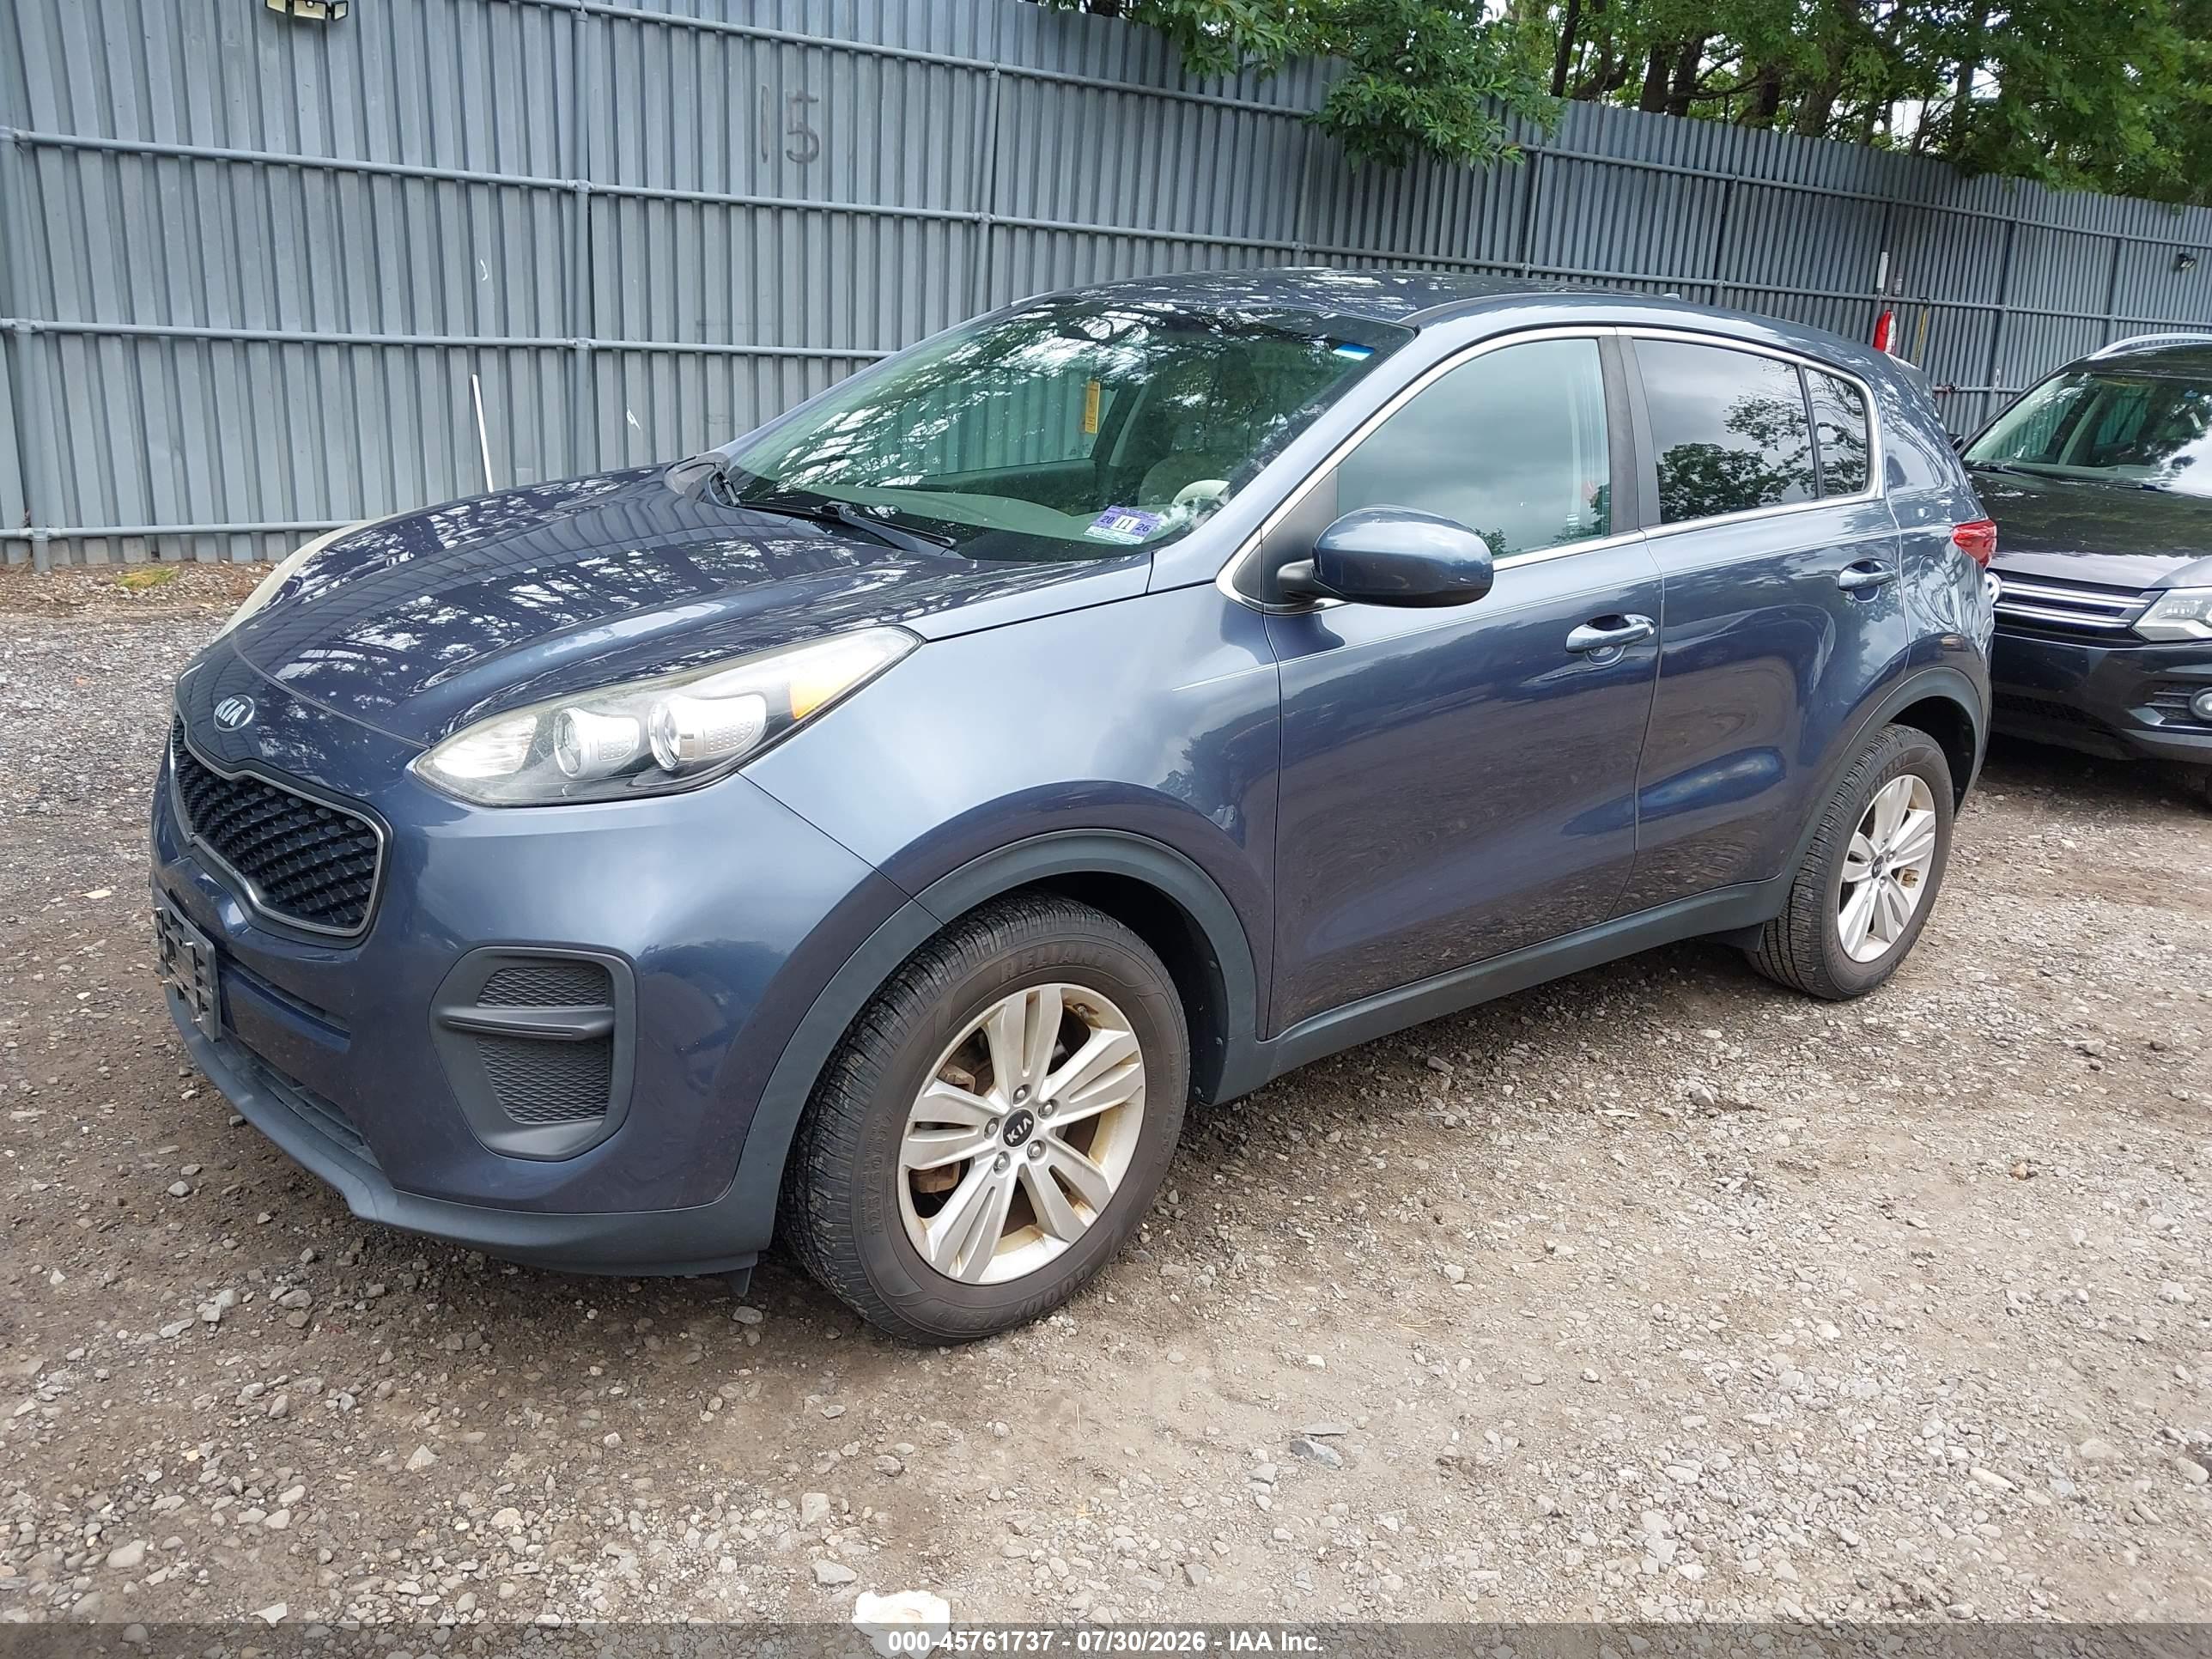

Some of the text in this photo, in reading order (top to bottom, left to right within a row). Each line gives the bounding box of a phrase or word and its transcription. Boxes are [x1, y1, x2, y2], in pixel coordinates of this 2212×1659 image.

[760, 84, 820, 165] 15
[1100, 515, 1153, 532] 20 11 26
[216, 697, 246, 726] KIA
[999, 945, 1115, 984] RELIANT
[1006, 1117, 1033, 1144] KIA
